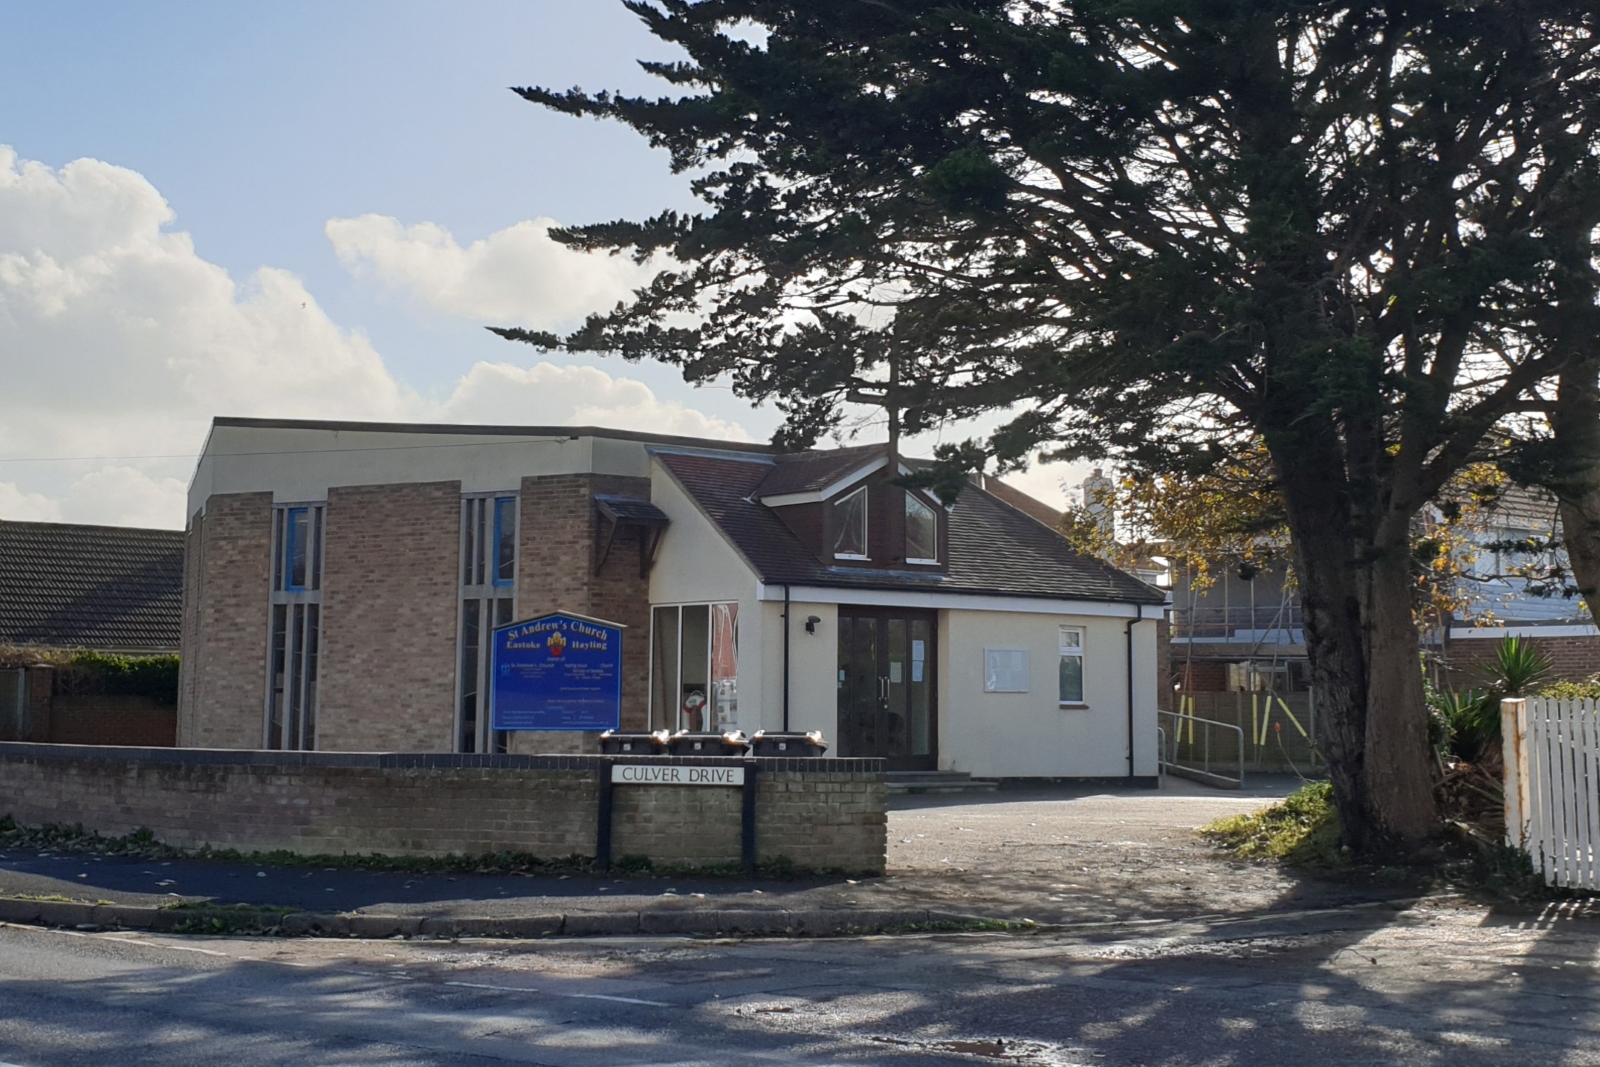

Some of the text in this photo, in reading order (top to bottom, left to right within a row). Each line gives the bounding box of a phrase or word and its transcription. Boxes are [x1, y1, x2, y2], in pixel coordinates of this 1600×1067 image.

[507, 620, 608, 641] St Andrew's Church
[506, 641, 607, 650] Eastoke Hayling
[622, 767, 735, 783] CULVER DRIVE
